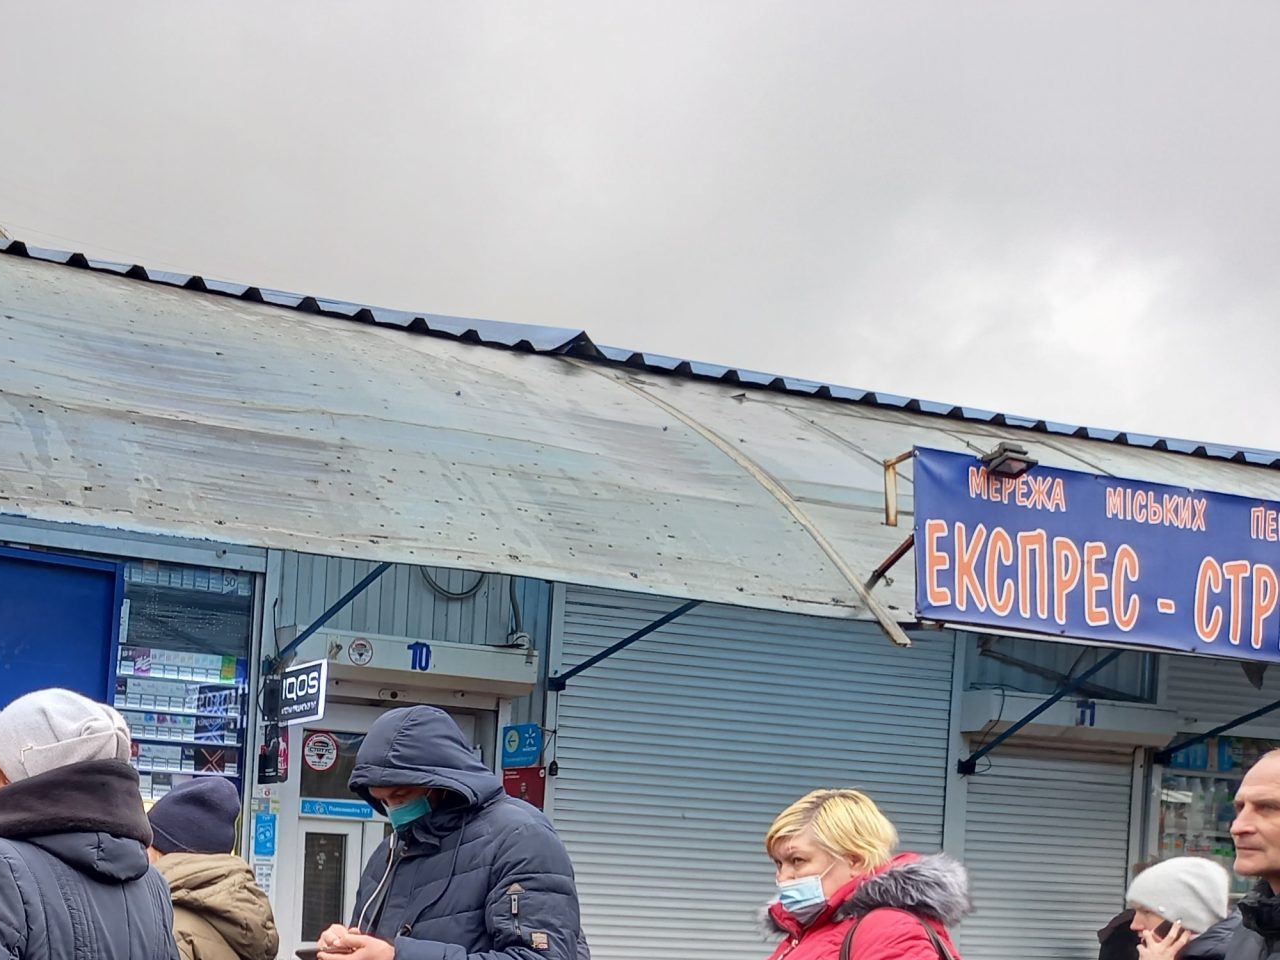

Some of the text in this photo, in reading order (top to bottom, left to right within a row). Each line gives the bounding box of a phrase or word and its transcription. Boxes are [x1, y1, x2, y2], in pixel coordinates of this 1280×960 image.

[969, 466, 1280, 543] МЕРЕЖА МІСЬКИХ ПЕ
[925, 518, 1140, 632] ЕКСПРЕС
[1194, 556, 1280, 650] СТР
[407, 641, 432, 671] 10
[282, 671, 319, 701] IQOS
